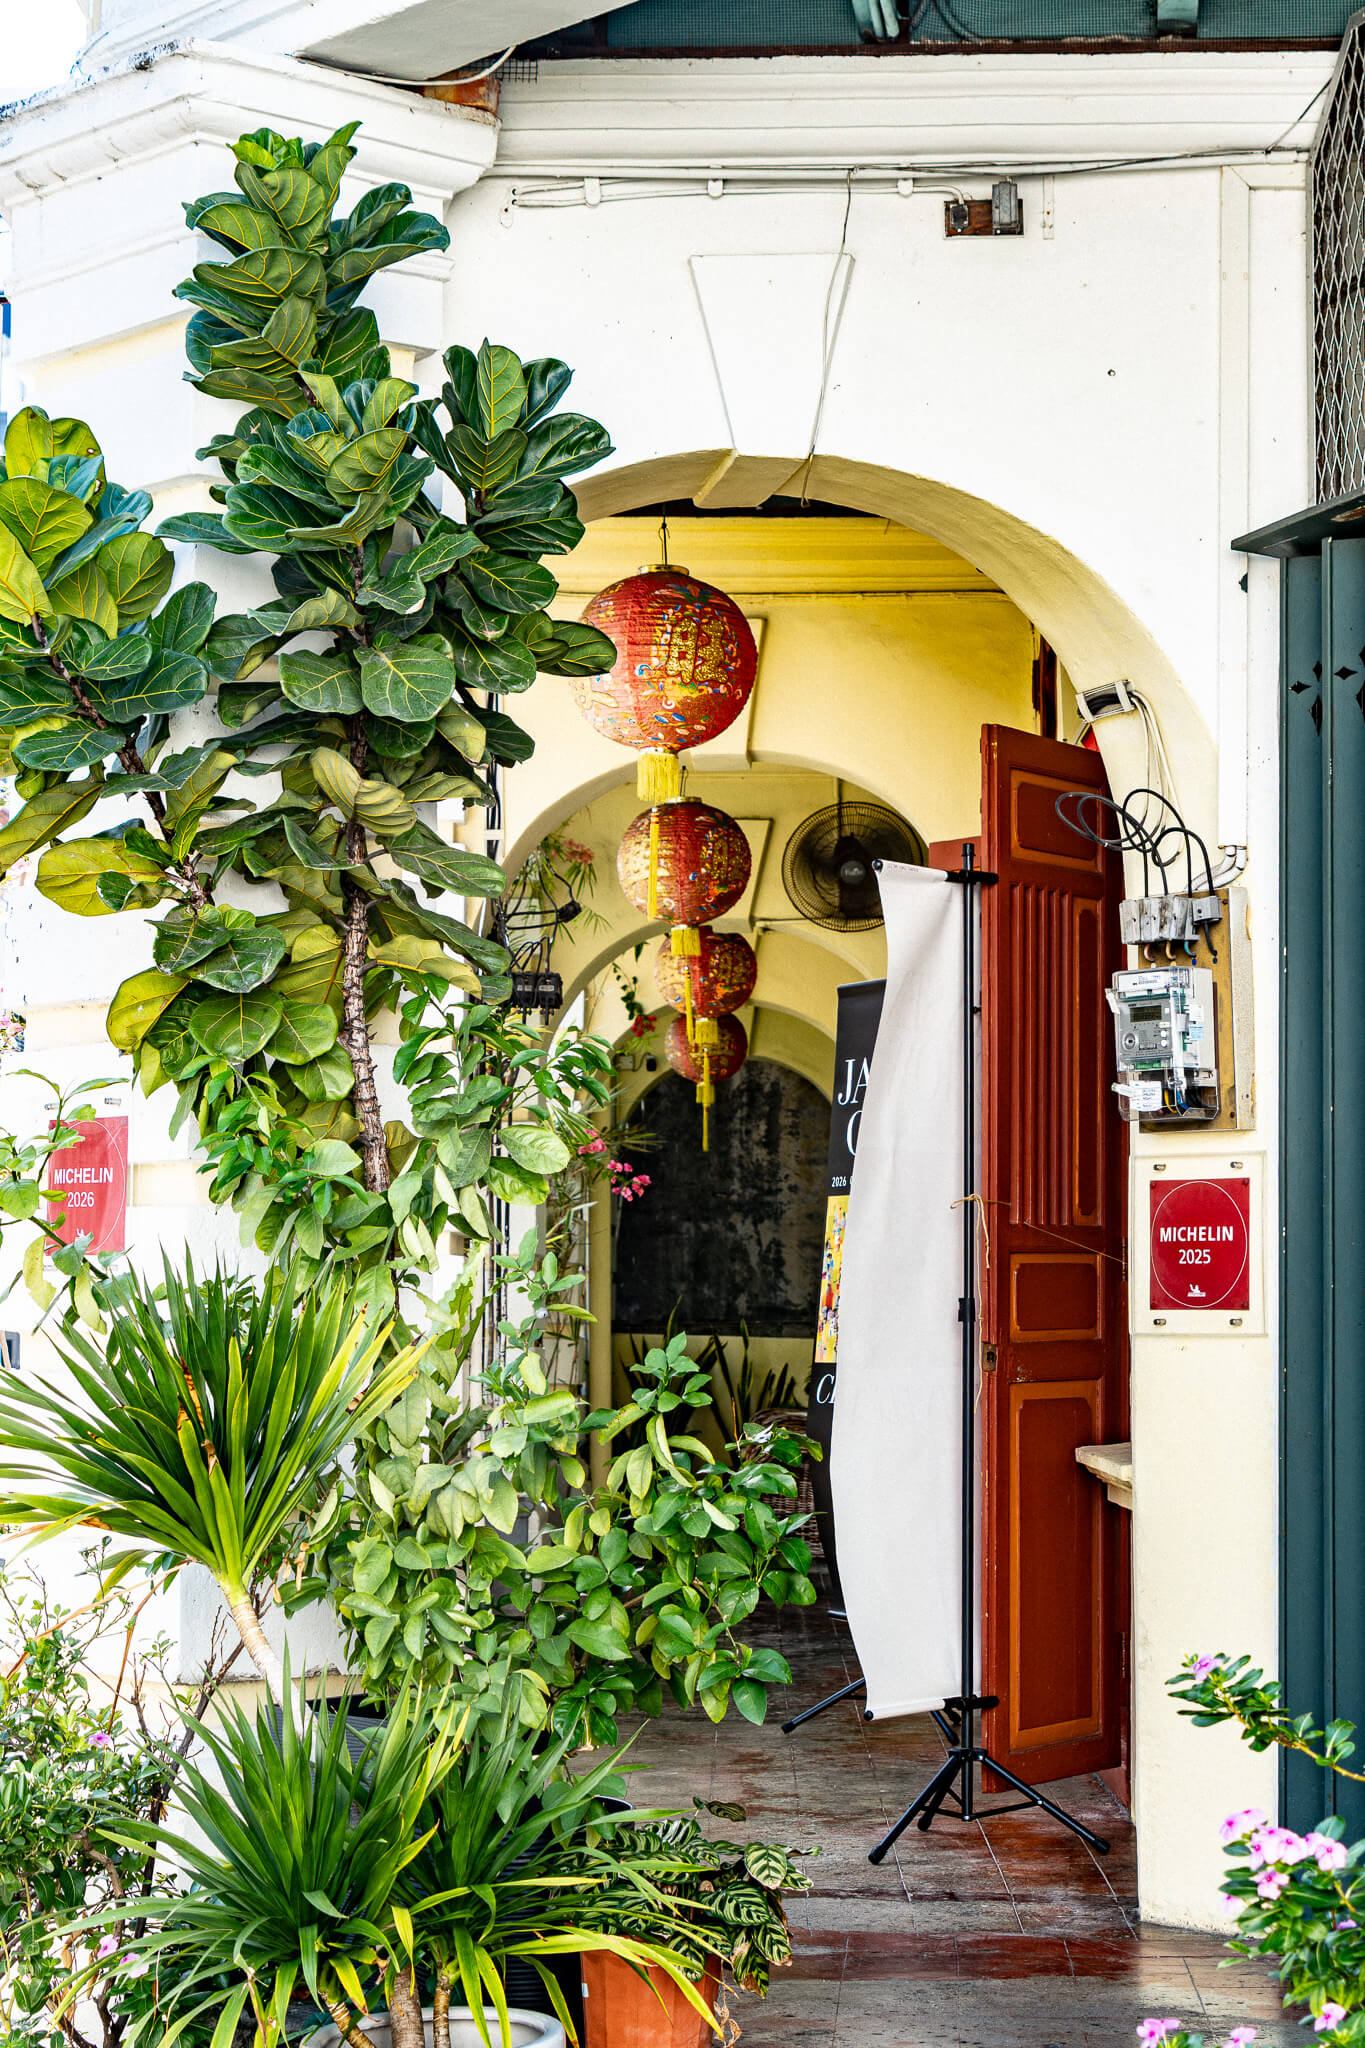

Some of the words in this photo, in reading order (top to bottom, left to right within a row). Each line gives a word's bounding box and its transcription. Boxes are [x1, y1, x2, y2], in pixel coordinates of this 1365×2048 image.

[838, 1056, 870, 1105] JA
[54, 1167, 114, 1184] MICHELIN
[831, 1175, 847, 1187] 2026
[67, 1191, 95, 1207] 2026
[1159, 1226, 1234, 1242] MICHELIN
[1178, 1249, 1212, 1264] 2025
